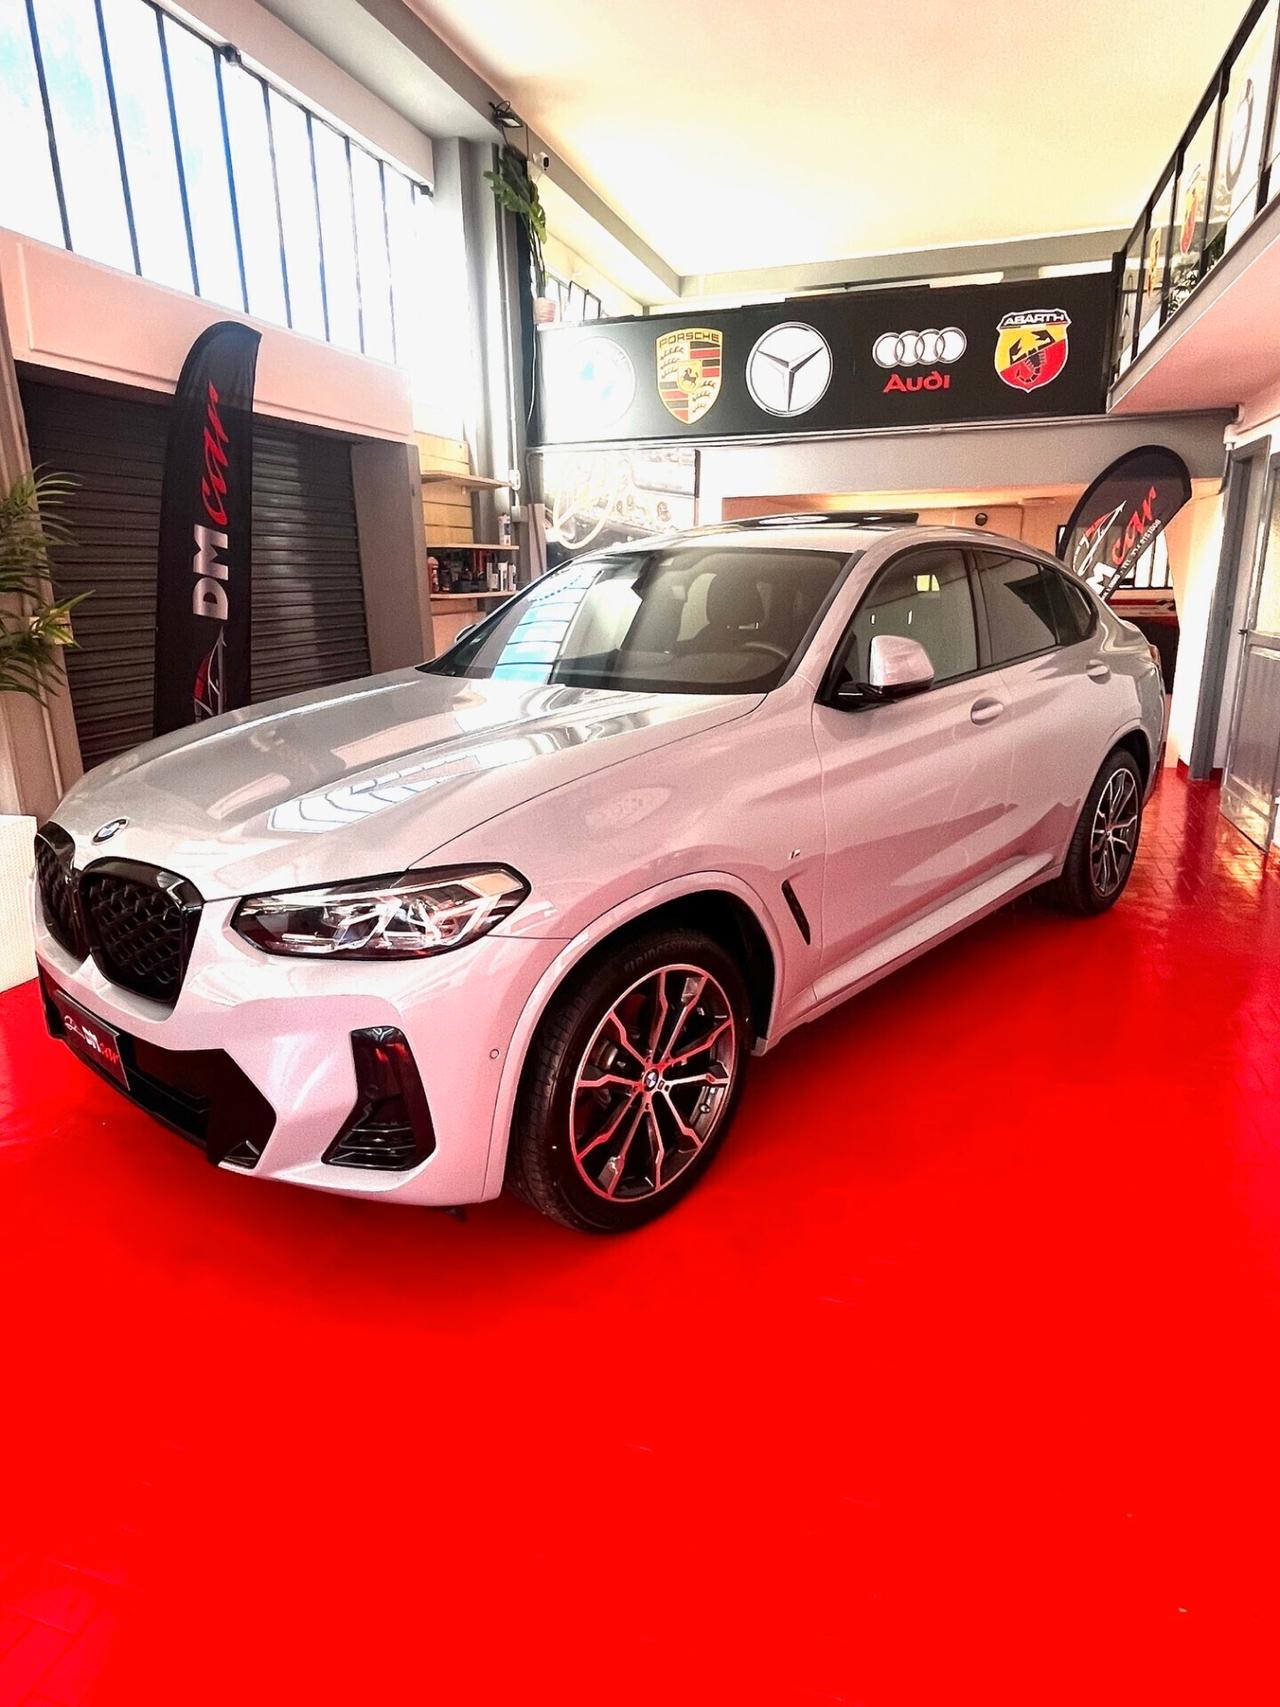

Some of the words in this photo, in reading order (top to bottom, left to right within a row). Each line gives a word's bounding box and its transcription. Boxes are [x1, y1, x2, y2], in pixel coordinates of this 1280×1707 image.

[659, 331, 720, 348] PORSCHE
[1004, 313, 1065, 326] ABARTH
[883, 371, 951, 393] Audi
[202, 379, 229, 526] car
[1086, 561, 1118, 597] M
[1112, 485, 1157, 565] car
[192, 524, 229, 620] DM
